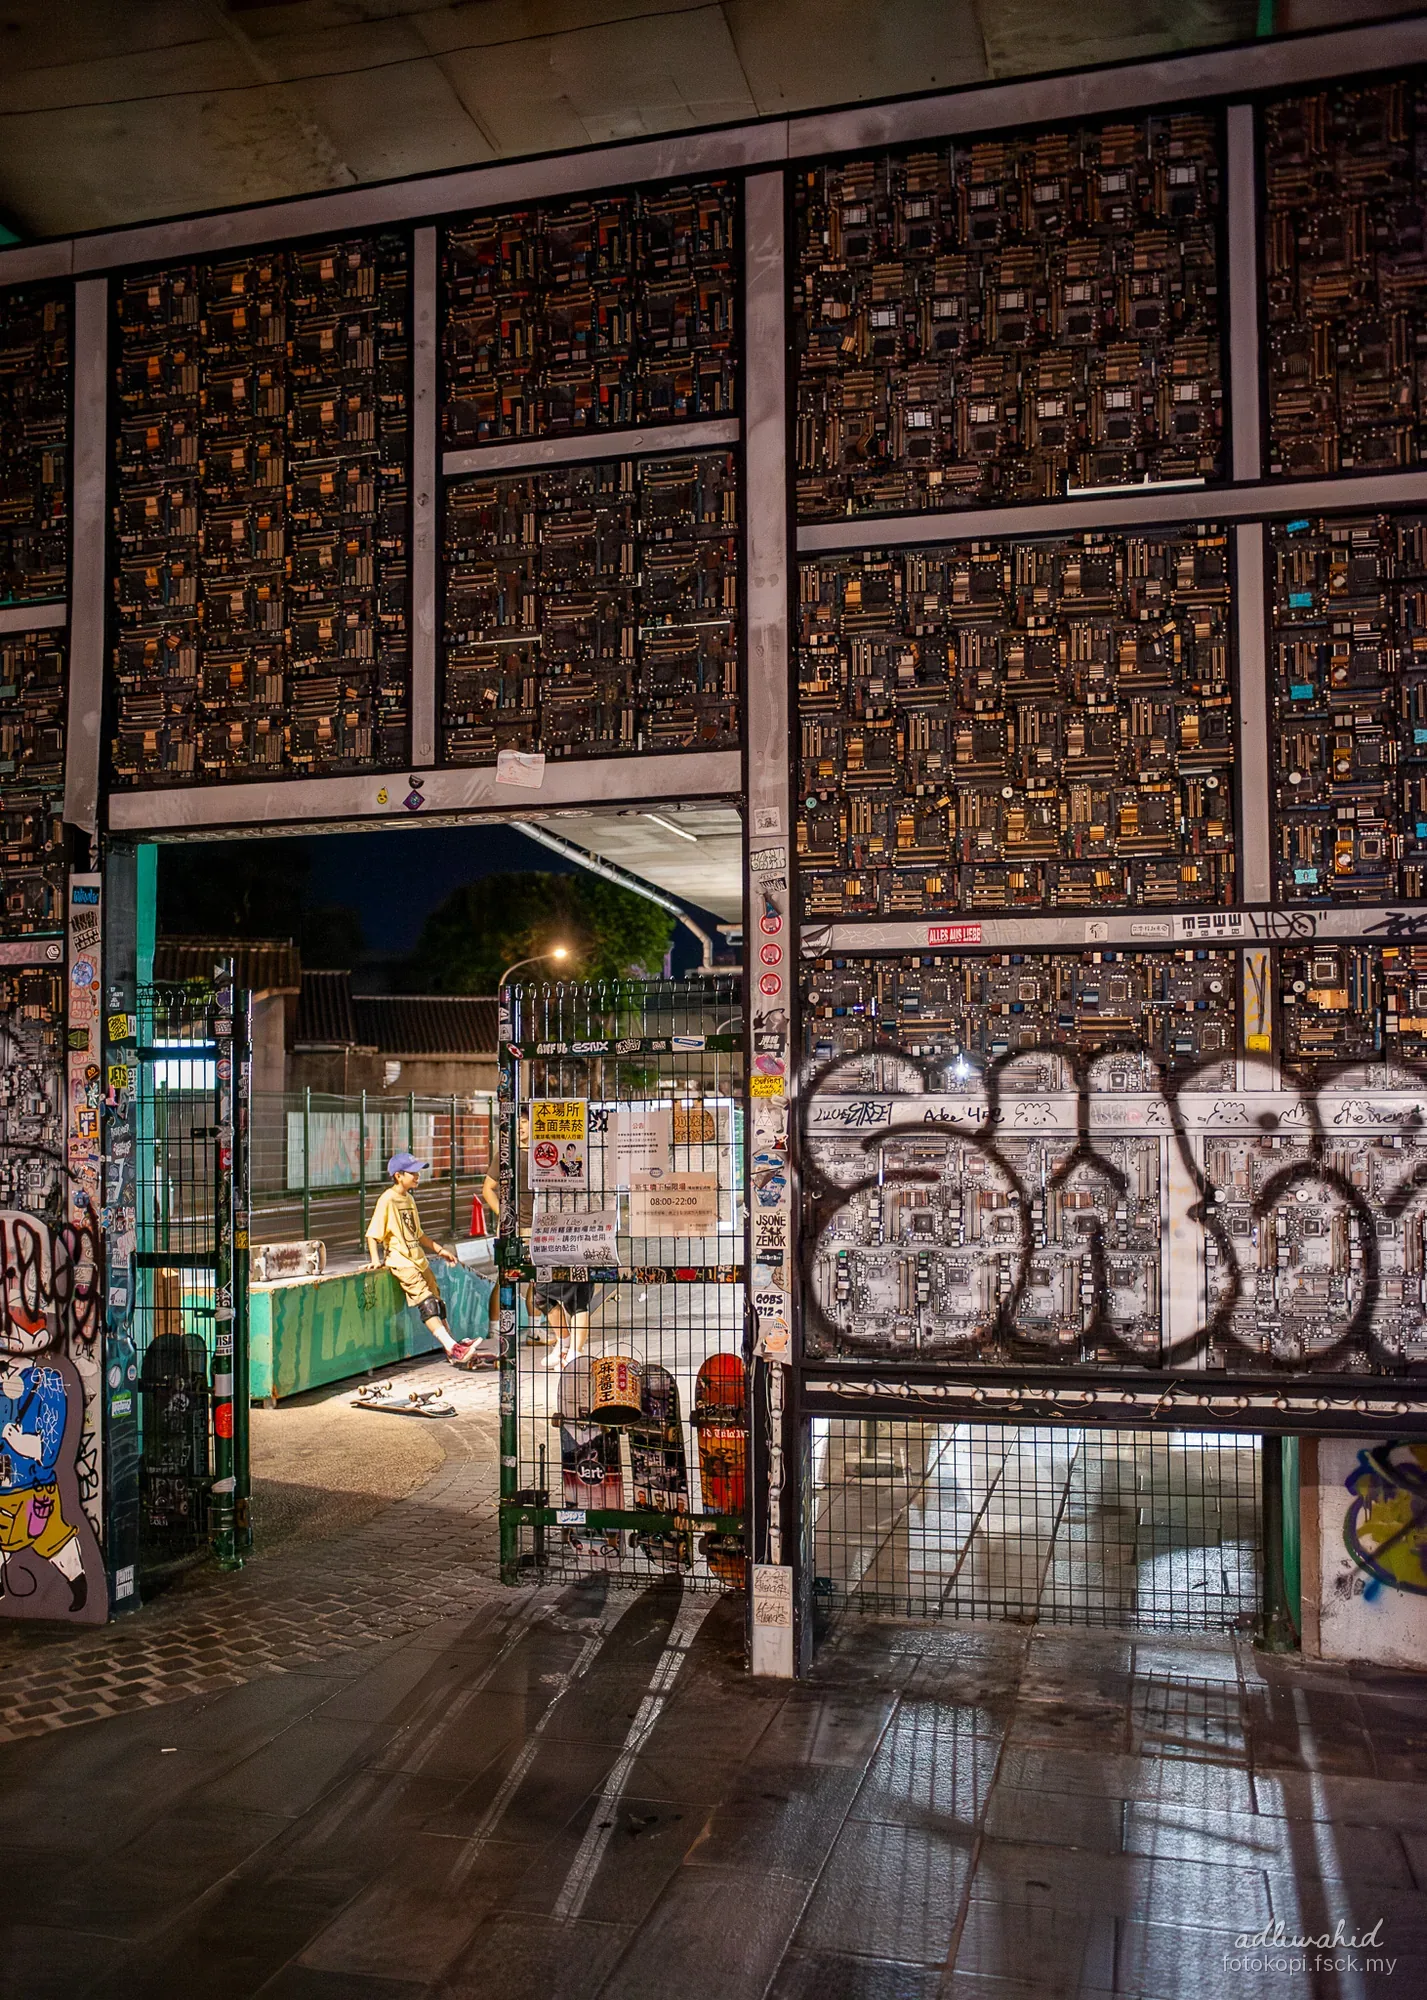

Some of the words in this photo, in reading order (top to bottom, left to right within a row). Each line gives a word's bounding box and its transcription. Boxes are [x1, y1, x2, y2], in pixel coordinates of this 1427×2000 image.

[929, 926, 949, 943] ALLES
[950, 925, 962, 942] AUS
[963, 924, 981, 942] LIEBE
[110, 1067, 127, 1082] JETS
[537, 1102, 580, 1117] 本場所
[80, 1112, 95, 1121] NZ
[534, 1119, 584, 1132] 全面禁菸
[500, 1131, 509, 1165] ZEMOK
[650, 1197, 697, 1206] 08:00-22:00
[756, 1214, 787, 1226] JSONE
[756, 1235, 787, 1247] ZEMOK
[598, 1361, 614, 1402] 麻醬王
[580, 1466, 605, 1479] Jart
